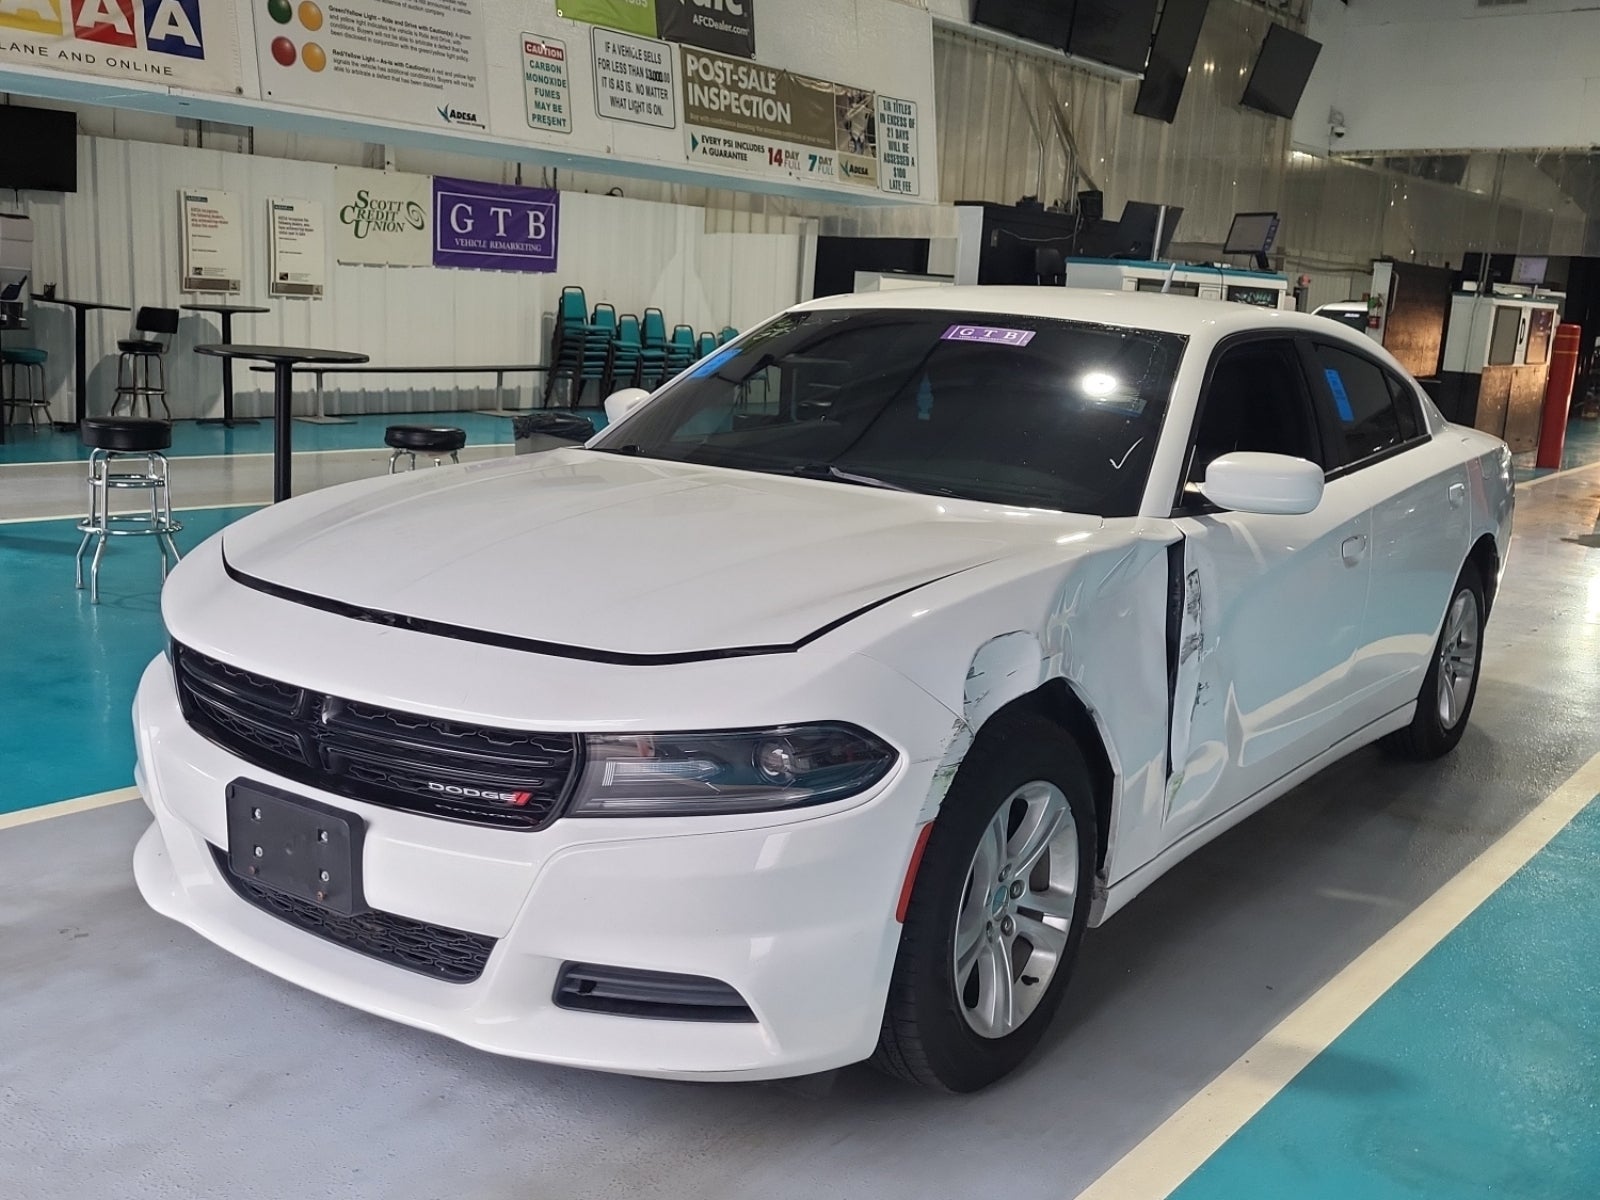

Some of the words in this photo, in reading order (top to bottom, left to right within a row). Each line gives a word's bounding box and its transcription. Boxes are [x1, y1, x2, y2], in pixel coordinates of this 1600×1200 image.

[526, 43, 563, 59] CAUTION
[605, 41, 610, 53] IF
[612, 43, 617, 55] A
[617, 44, 643, 61] VEHICLE
[643, 50, 662, 65] SELLS
[58, 50, 96, 64] AND
[106, 57, 174, 76] ONLINE
[529, 60, 562, 74] CARBON
[598, 57, 611, 71] FOR
[612, 60, 627, 75] LESS
[628, 63, 644, 78] THAN
[526, 72, 567, 88] MONOXIDE
[686, 53, 776, 95] POST-SALE
[534, 87, 561, 100] FUMES
[608, 77, 615, 90] IS
[616, 79, 624, 91] AS
[635, 83, 645, 95] NO
[645, 85, 669, 100] MATTER
[534, 101, 551, 111] MAY
[552, 103, 563, 114] BE
[609, 95, 626, 109] WHAT
[628, 98, 645, 113] LIGHT
[688, 81, 792, 124] INSPECTION
[893, 101, 911, 116] TITLES
[532, 113, 567, 127] PRESENT
[887, 114, 907, 128] EXCESS
[701, 134, 721, 145] EVERY
[723, 138, 733, 148] PSI
[735, 140, 765, 153] INCLUDES
[702, 146, 707, 155] A
[709, 147, 748, 161] GUARANTEE
[768, 147, 783, 167] 14
[785, 149, 800, 160] DAY
[808, 153, 818, 172] 7
[818, 156, 833, 166] DAY
[883, 152, 910, 167] ASSESSED
[911, 156, 915, 167] A
[784, 160, 800, 170] FULL
[818, 165, 834, 176] FULL
[902, 181, 911, 192] FEE
[354, 189, 404, 211] SCOTT
[339, 204, 399, 224] CREDIT
[353, 219, 405, 239] UNION
[455, 238, 487, 248] VEHICLE
[490, 240, 541, 252] REMARKETING
[428, 782, 517, 802] DODGE
